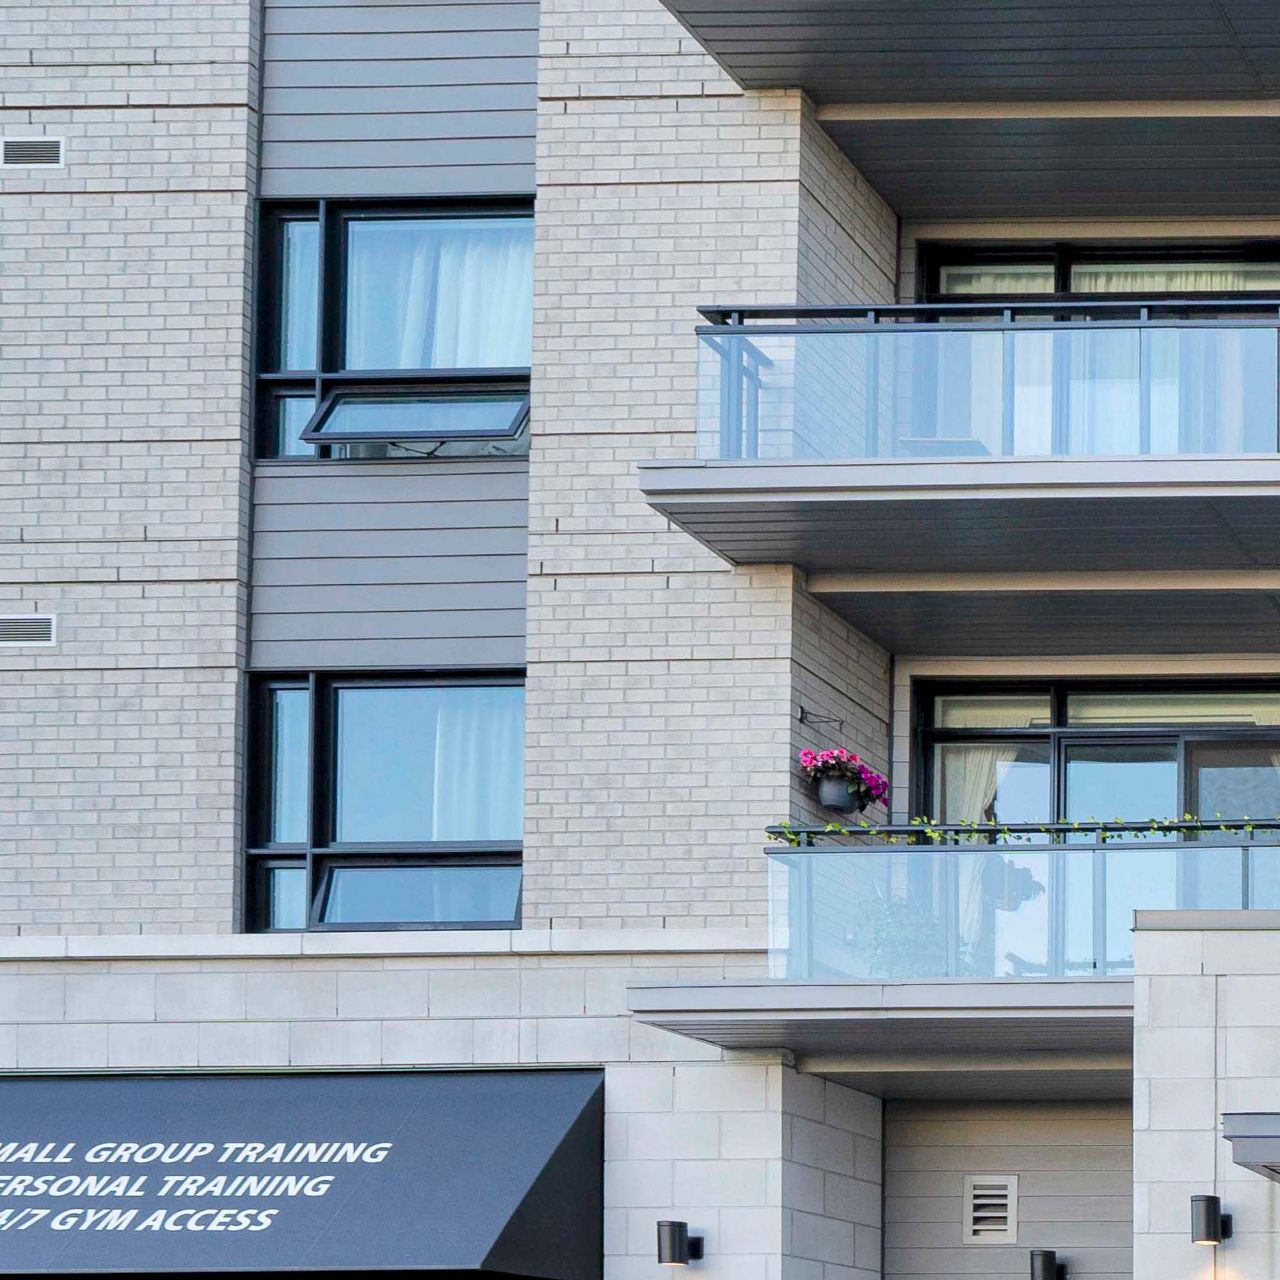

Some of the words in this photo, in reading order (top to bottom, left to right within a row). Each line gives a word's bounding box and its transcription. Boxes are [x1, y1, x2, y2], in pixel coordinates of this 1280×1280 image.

[84, 1142, 215, 1163] GROUP
[217, 1142, 393, 1163] TRAINING
[157, 1175, 336, 1196] TRAINING
[50, 1208, 139, 1231] GYM
[134, 1208, 280, 1231] ACCESS
